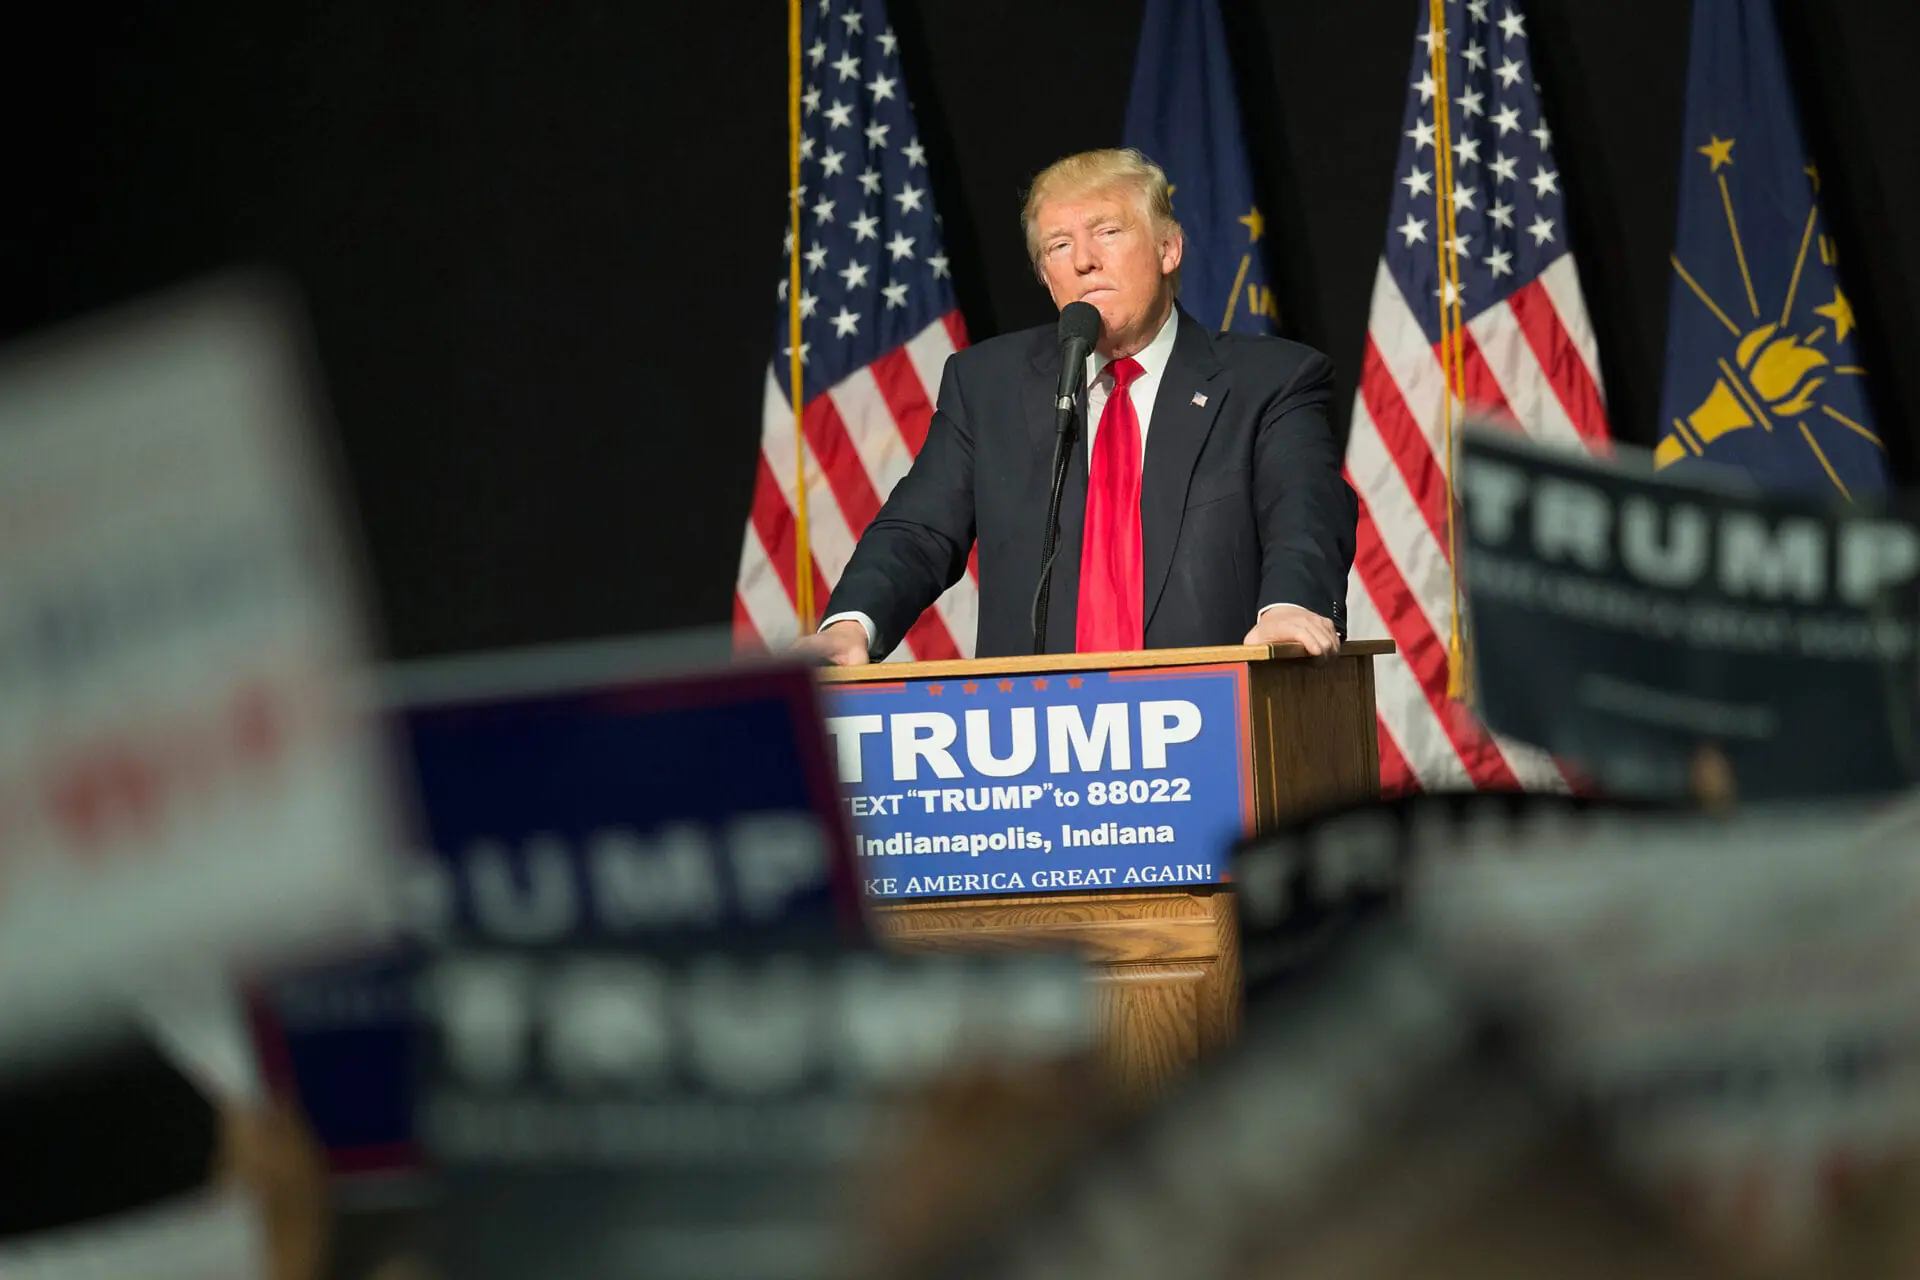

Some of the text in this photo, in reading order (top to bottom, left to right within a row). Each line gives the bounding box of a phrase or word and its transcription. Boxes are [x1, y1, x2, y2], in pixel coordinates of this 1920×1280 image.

[1464, 454, 1920, 603] TRUMP
[825, 699, 1203, 783] TRUMP
[1053, 787, 1080, 808] to
[1087, 777, 1191, 806] 88022
[856, 822, 1175, 857] Indianapolis, Indiana
[404, 810, 828, 942] UMP
[864, 863, 1212, 896] KE AMERICA GREAT AGAIN!
